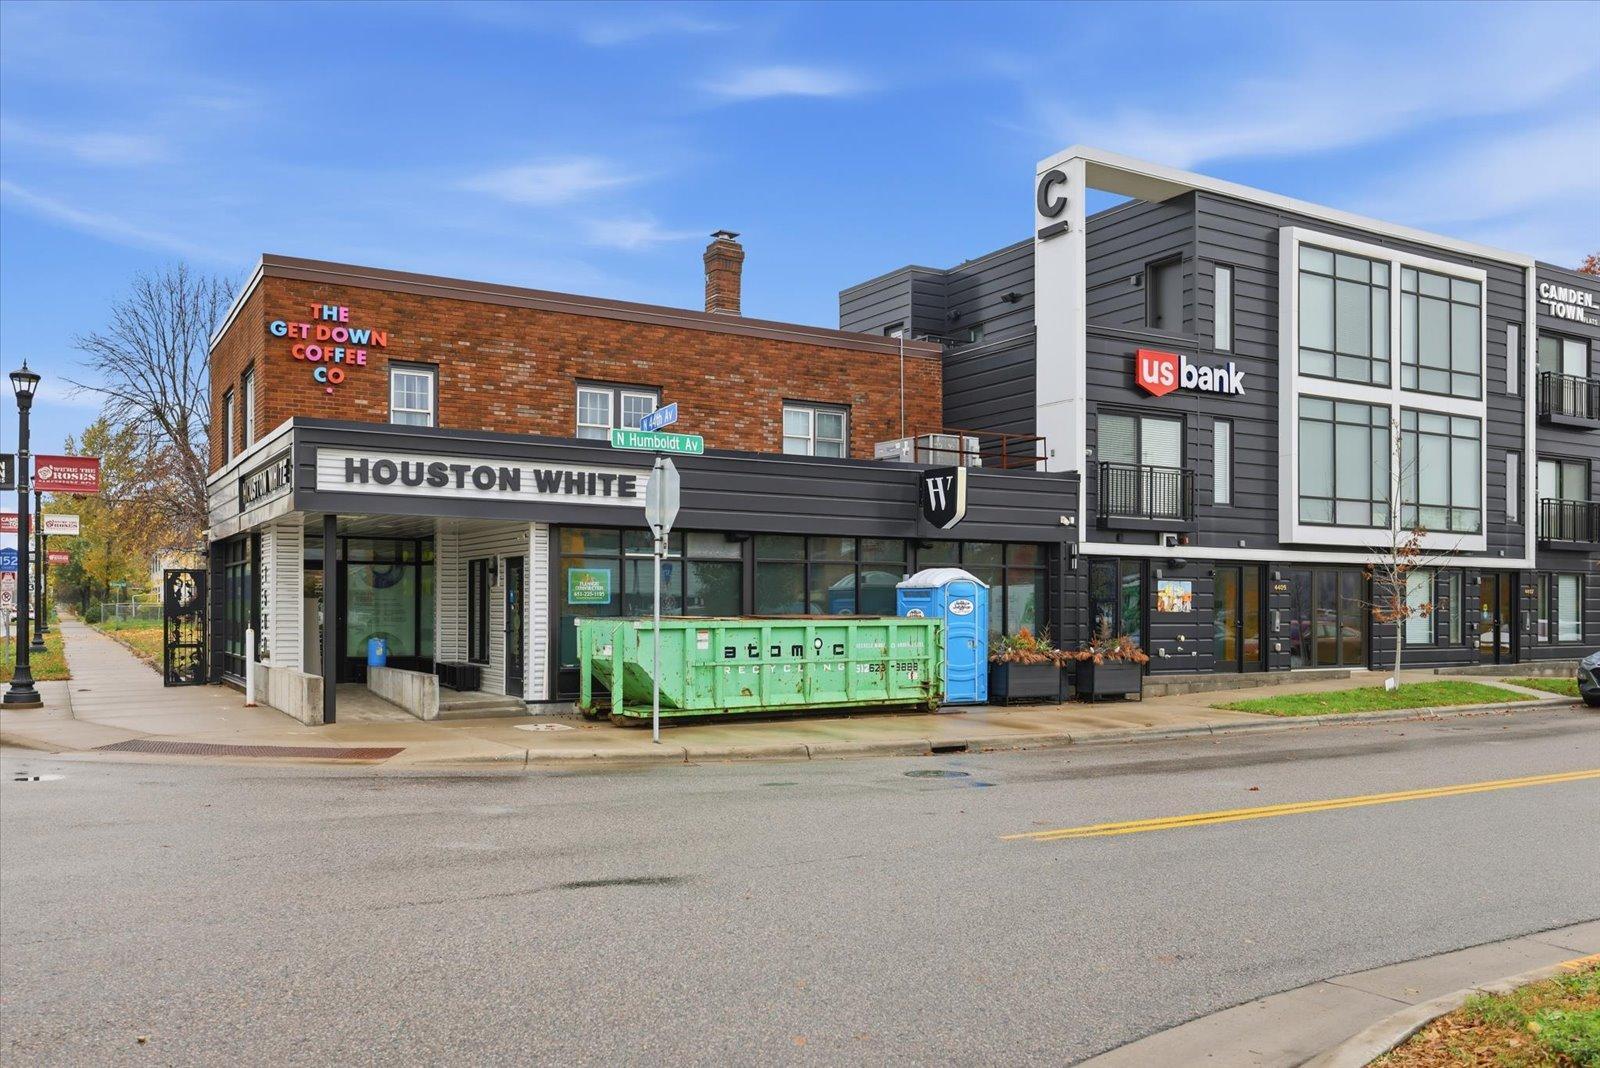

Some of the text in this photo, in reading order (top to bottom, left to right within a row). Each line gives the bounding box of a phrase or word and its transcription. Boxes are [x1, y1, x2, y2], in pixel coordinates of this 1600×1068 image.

[1037, 169, 1068, 218] C
[1540, 282, 1593, 307] CAMDEN
[310, 303, 350, 323] THE
[1550, 301, 1584, 323] TOWN
[270, 320, 388, 347] GET DOWN
[291, 343, 367, 366] COFFEE
[1180, 354, 1246, 395] bank
[643, 419, 648, 430] N
[617, 432, 698, 452] N Humboldt Av
[53, 472, 96, 481] ROSES
[345, 457, 637, 498] HOUSTON WHITE
[724, 637, 845, 659] atomic
[724, 662, 846, 674] RECYCLING
